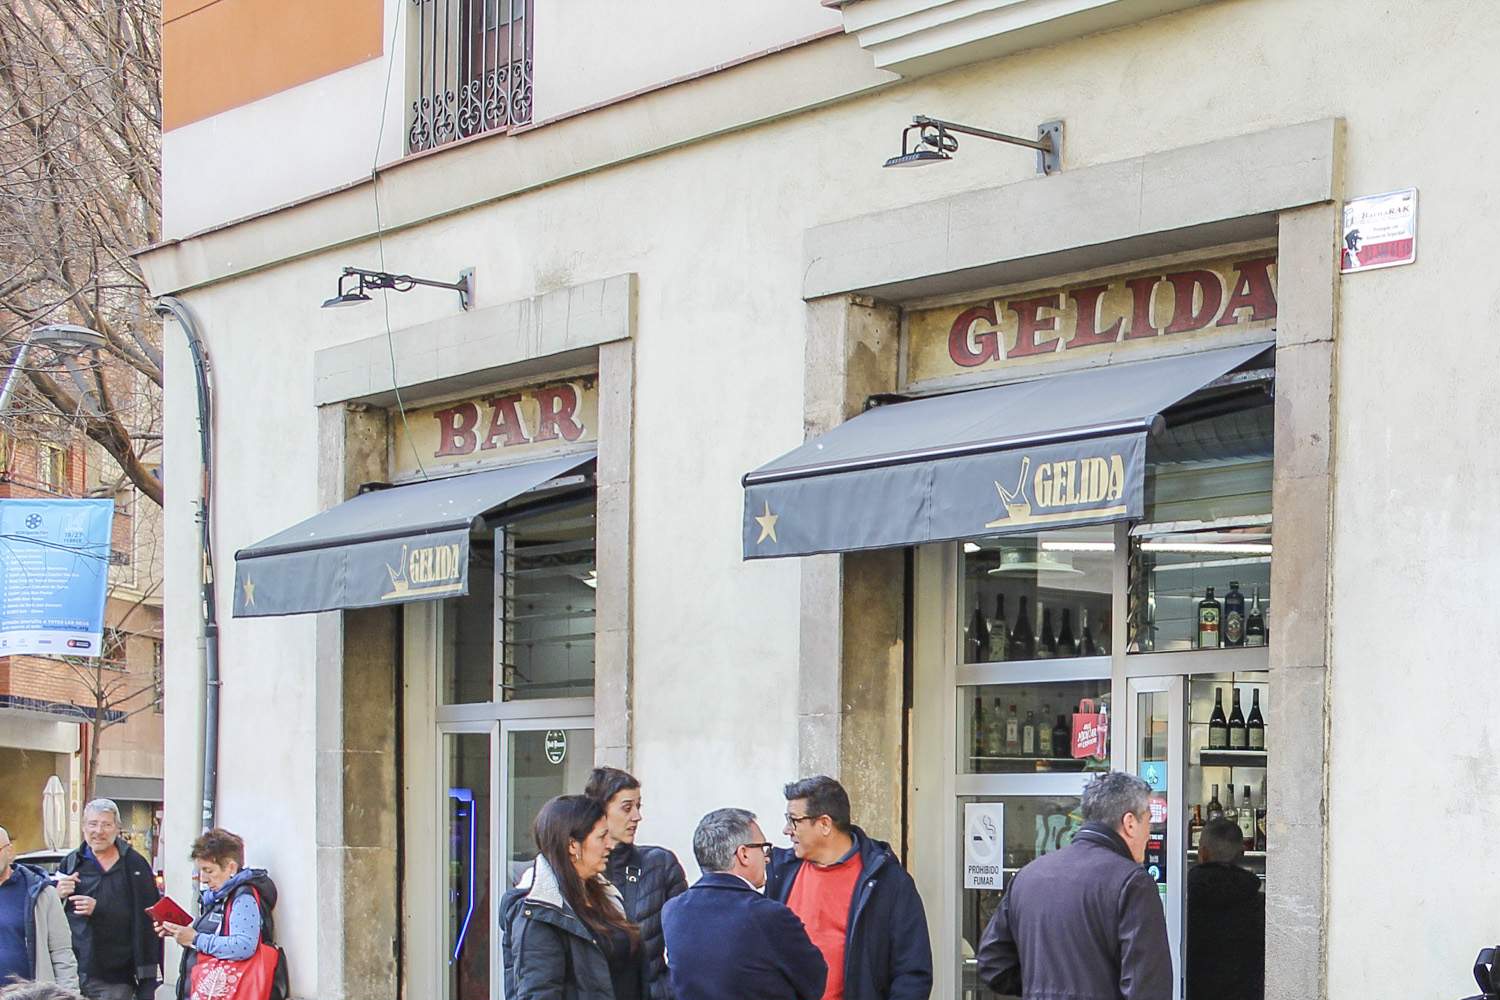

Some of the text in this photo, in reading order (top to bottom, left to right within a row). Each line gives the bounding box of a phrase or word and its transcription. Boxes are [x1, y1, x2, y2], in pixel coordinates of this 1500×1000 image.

[948, 256, 1277, 367] GELIDA
[433, 383, 584, 457] BAR
[1034, 455, 1124, 507] GELIDA
[410, 544, 459, 583] GELIDA
[968, 865, 999, 875] PROHIBIDO
[973, 876, 994, 886] FUMAR
